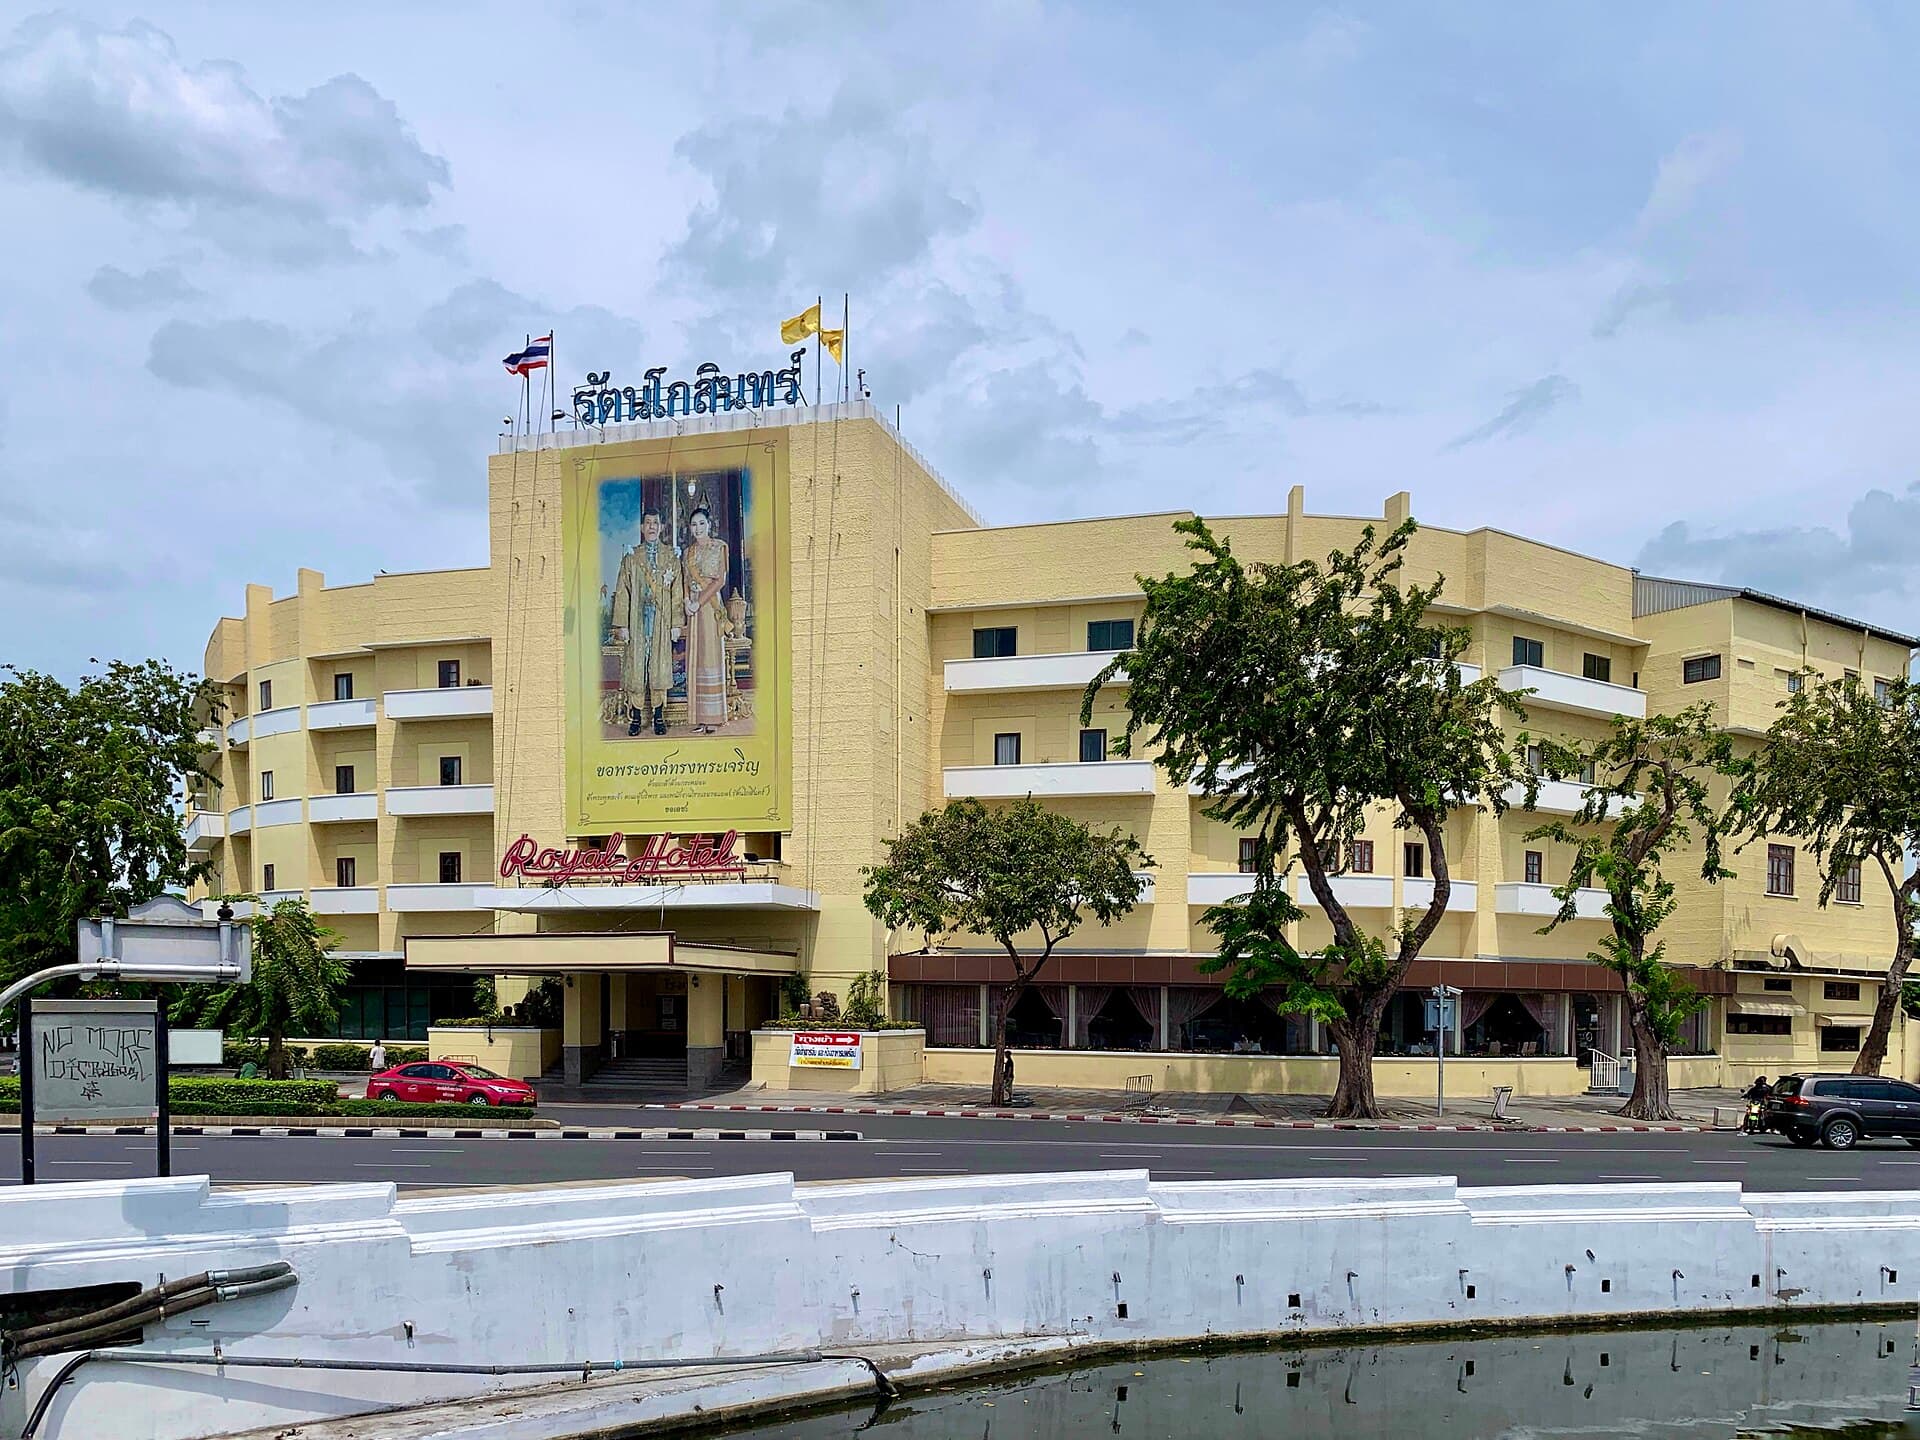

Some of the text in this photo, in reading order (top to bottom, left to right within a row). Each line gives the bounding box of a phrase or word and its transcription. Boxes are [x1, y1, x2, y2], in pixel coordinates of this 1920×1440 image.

[574, 347, 806, 424] รัตนโกสินทร์
[596, 747, 760, 777] ขอพระองค์ทรงพระเจริญ
[500, 829, 740, 882] Royal Hotel
[43, 1026, 153, 1082] NO MORE
